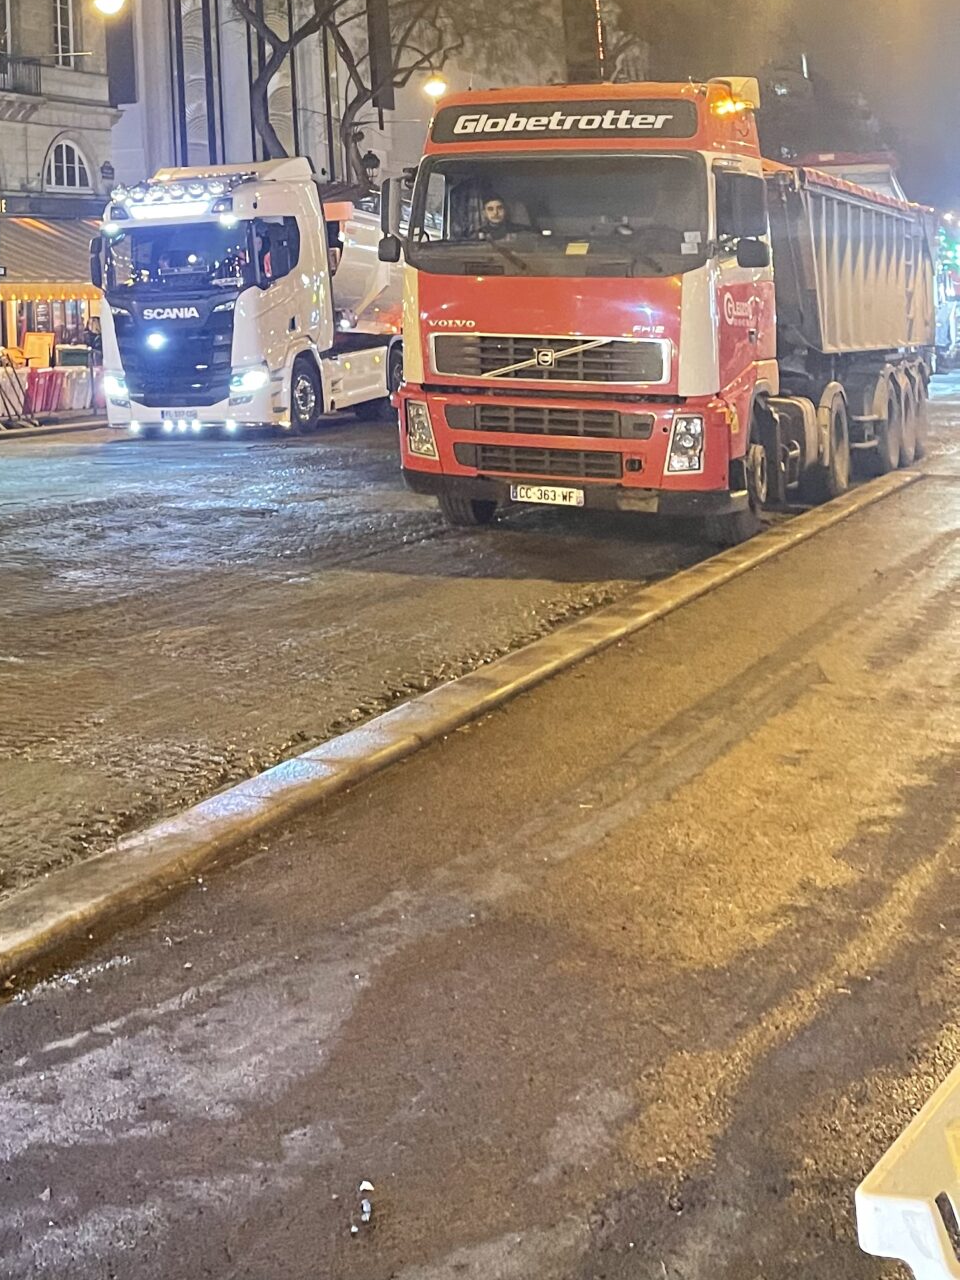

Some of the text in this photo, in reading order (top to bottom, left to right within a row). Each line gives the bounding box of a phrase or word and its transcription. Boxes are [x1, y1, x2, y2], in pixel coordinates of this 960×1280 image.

[453, 109, 673, 134] Globetrotter
[143, 307, 200, 320] SCANIA
[428, 319, 476, 328] VOLVO
